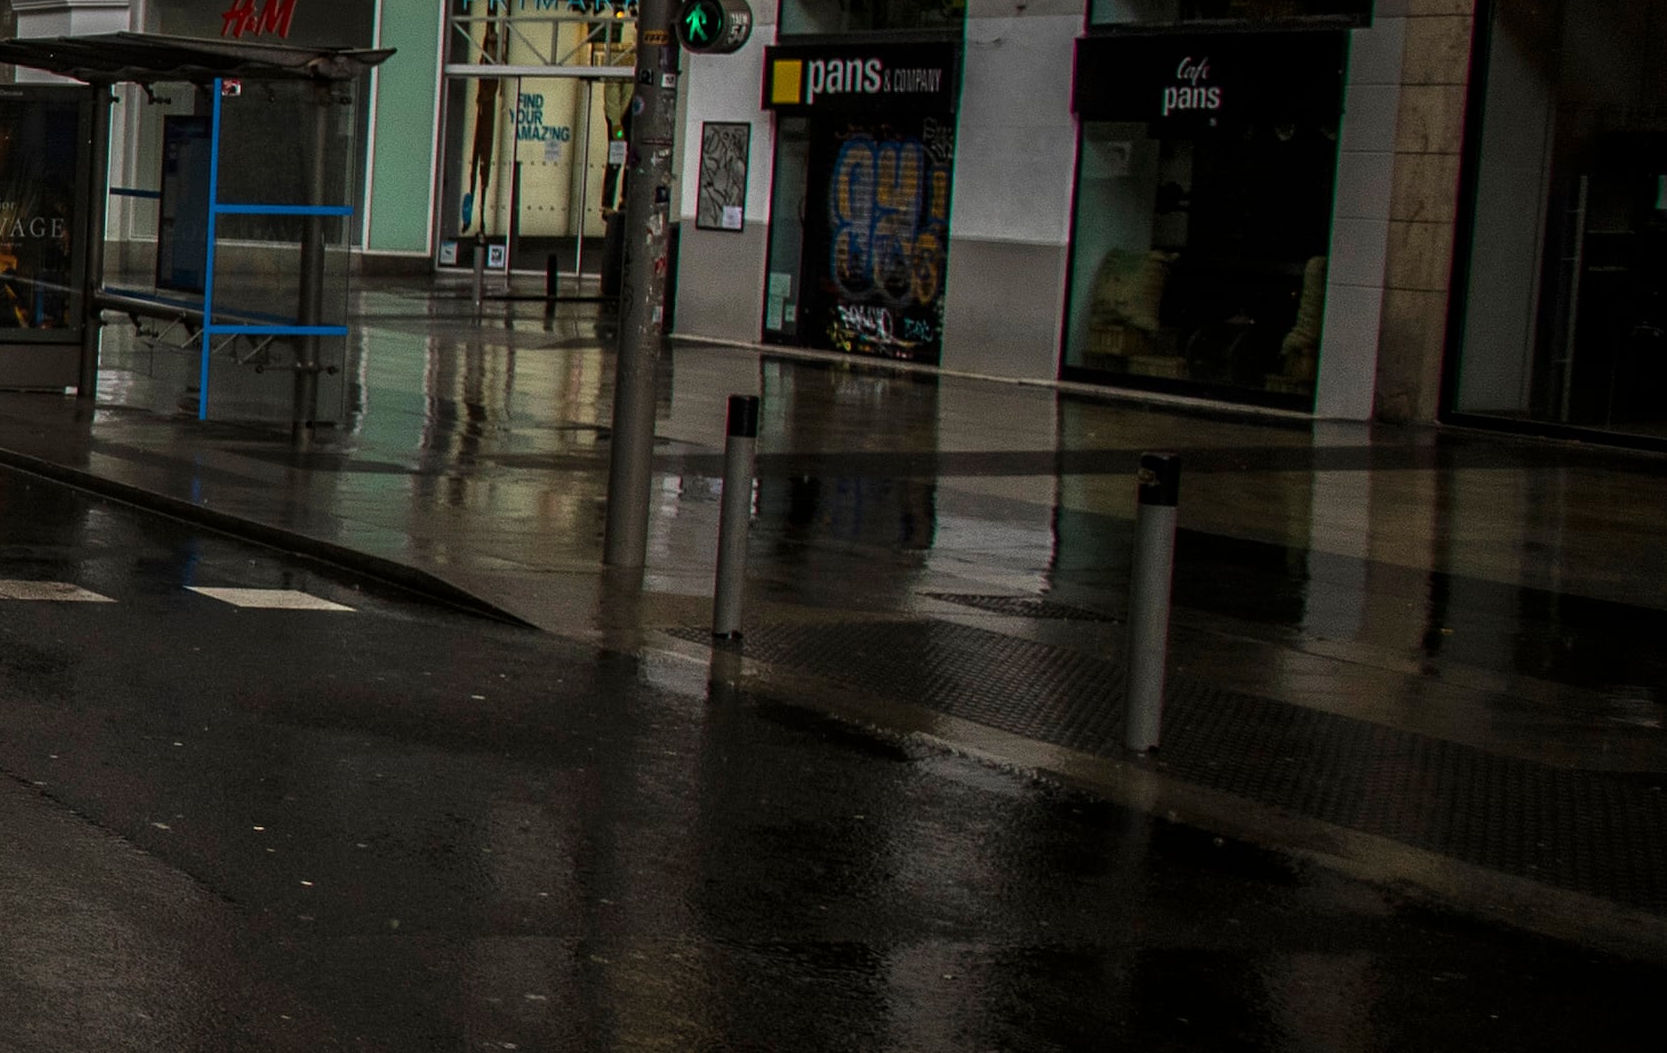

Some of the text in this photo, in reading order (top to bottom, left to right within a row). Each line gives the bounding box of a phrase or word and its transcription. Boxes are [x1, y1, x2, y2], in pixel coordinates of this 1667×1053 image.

[805, 55, 883, 106] pans
[893, 67, 944, 93] COMPANY
[517, 93, 544, 109] FIND
[1162, 85, 1223, 117] pans
[508, 108, 543, 126] YOUR
[515, 125, 571, 142] AMAZING
